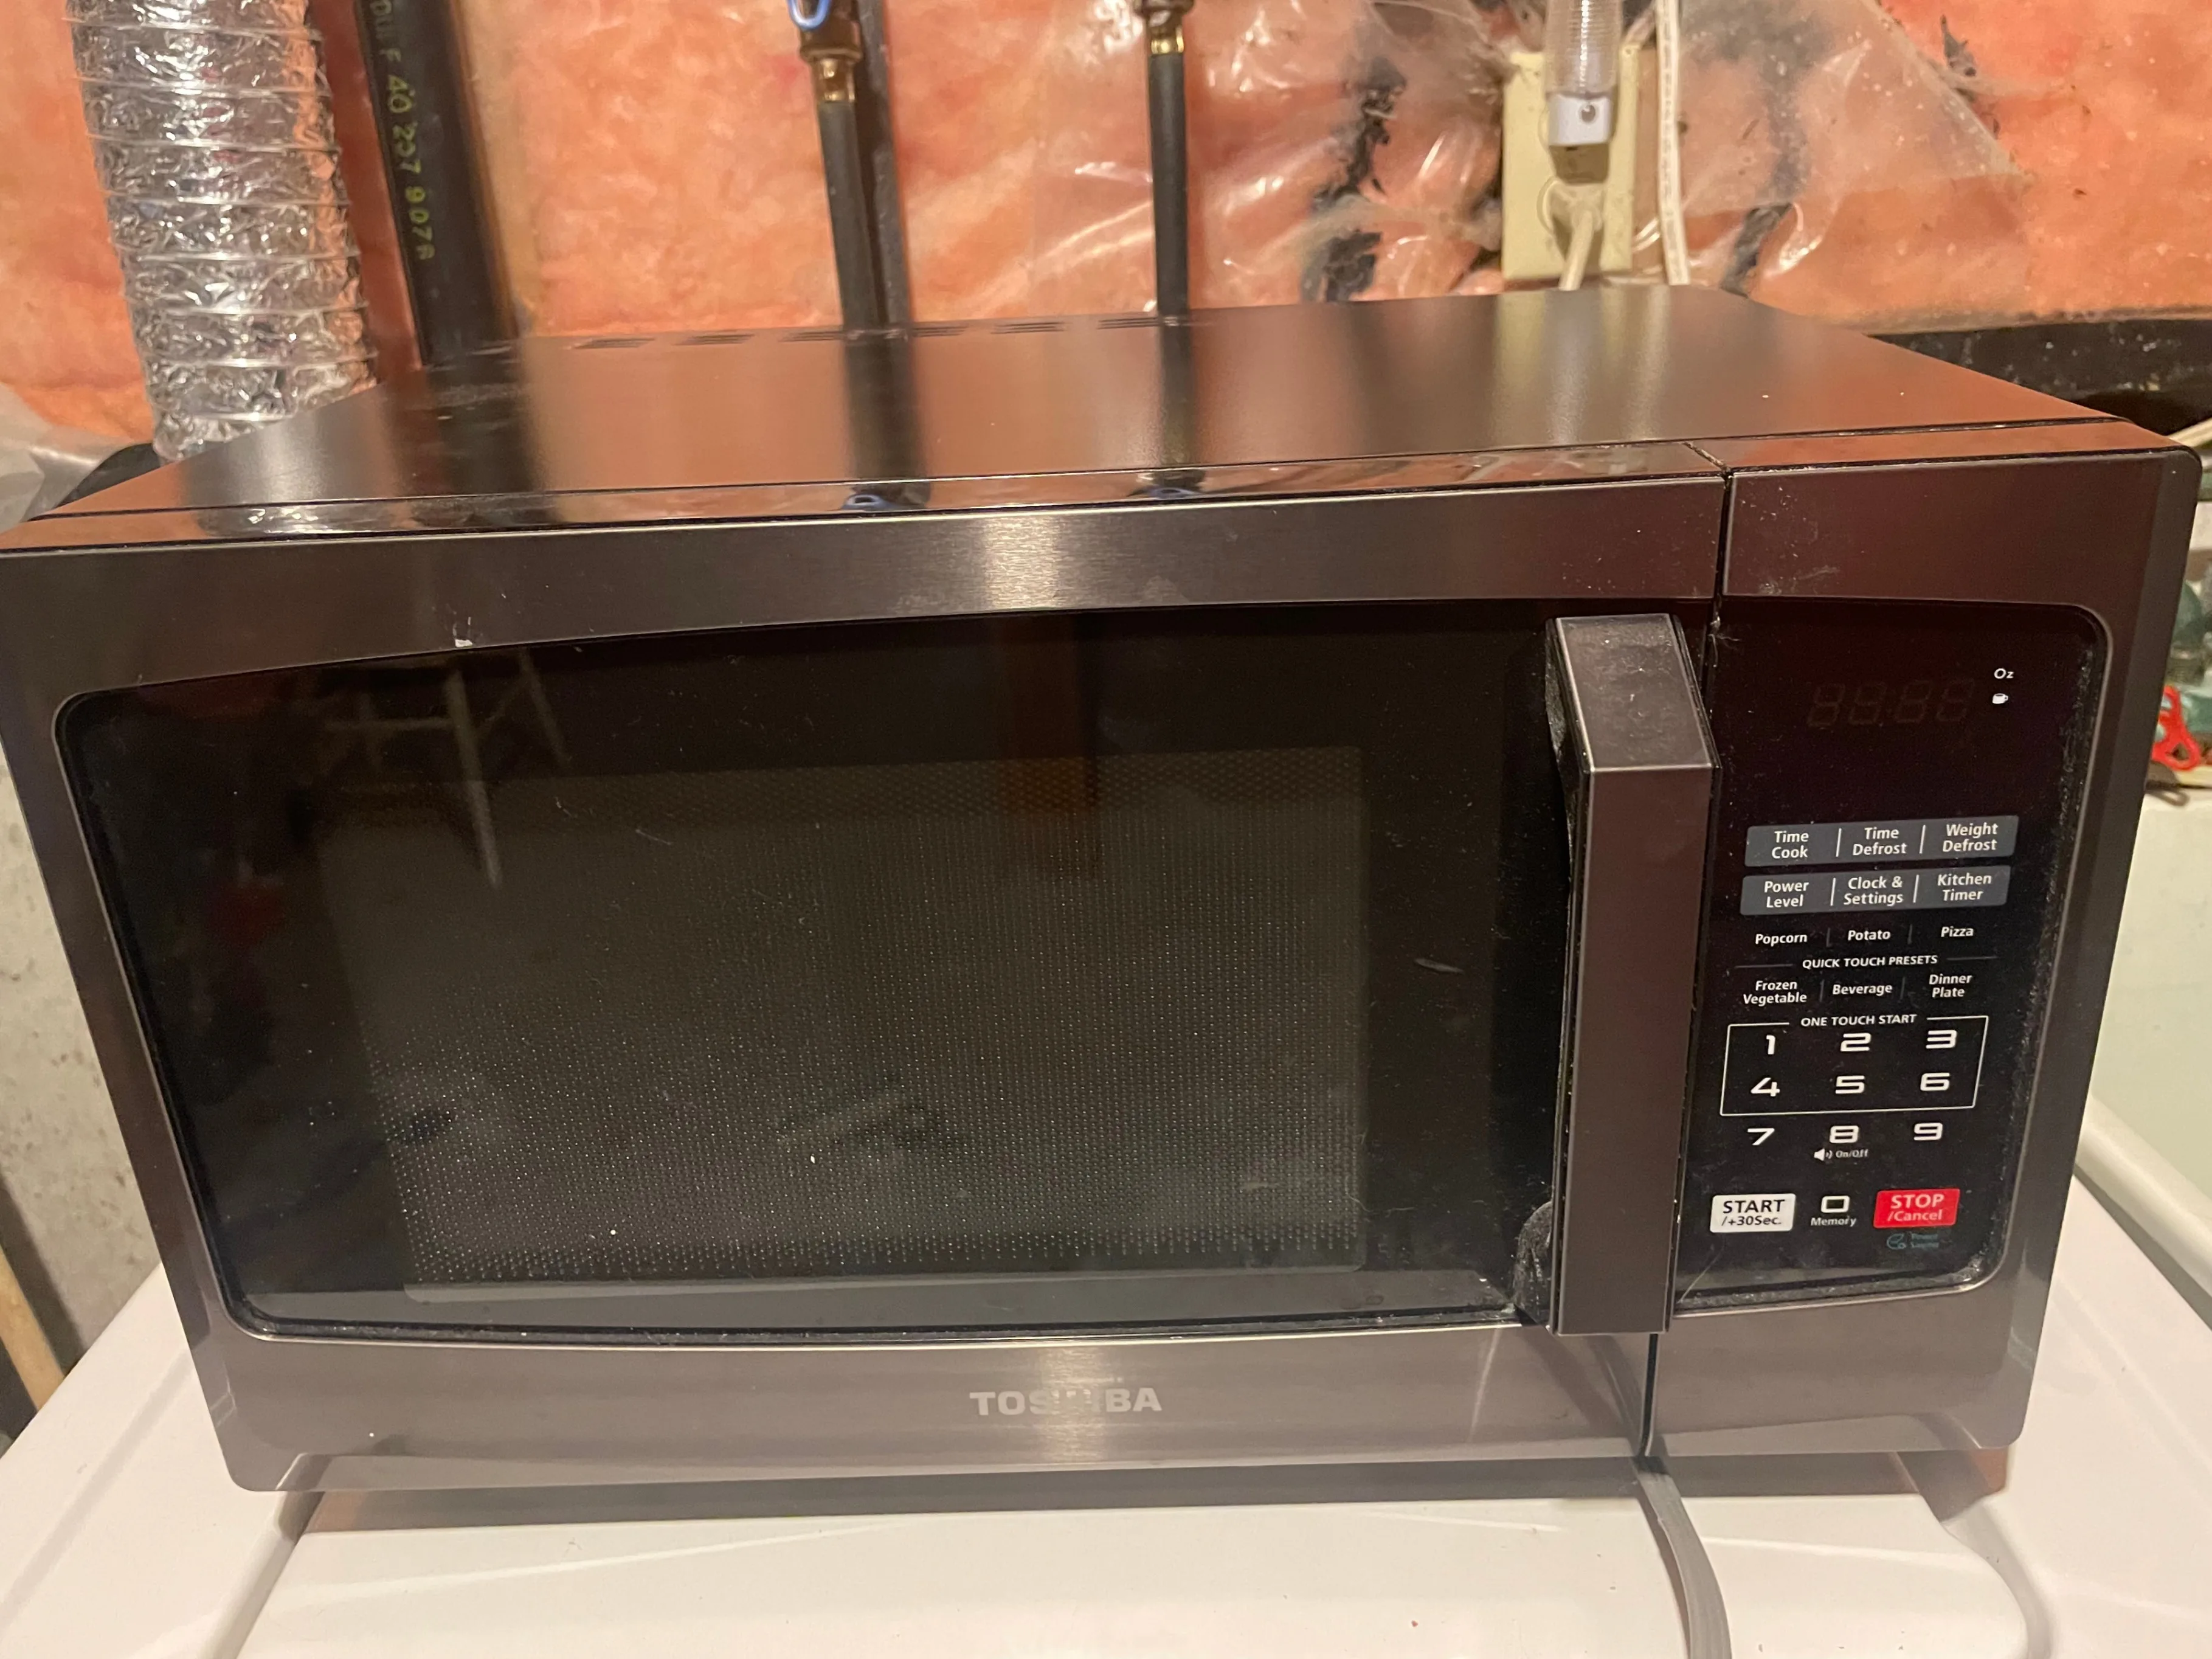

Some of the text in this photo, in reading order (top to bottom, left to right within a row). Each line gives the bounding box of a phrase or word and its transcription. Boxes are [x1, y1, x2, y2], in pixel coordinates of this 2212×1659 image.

[1994, 668, 2014, 679] Oz
[1774, 830, 1809, 843] Time
[1864, 826, 1899, 840] Time
[1946, 822, 1999, 839] Weight
[1852, 842, 1907, 856] Defrost
[1942, 836, 1997, 853] Defrost
[1771, 845, 1808, 859] Cook
[1848, 876, 1903, 890] Clock &
[1937, 872, 1992, 886] Kitchen
[1764, 881, 1809, 893] Power
[1766, 894, 1804, 908] Level
[1843, 892, 1904, 907] Settings
[1942, 888, 1983, 901] Timer
[1847, 930, 1891, 941] Potato
[1941, 926, 1974, 938] Pizza
[1755, 933, 1808, 947] Popcorn
[1802, 955, 1938, 970] QUICK TOUCH PRESETS
[1755, 980, 1798, 991] Frozen
[1929, 973, 1972, 985] Dinner
[1832, 984, 1893, 997] Beverage
[1932, 986, 1965, 998] Plate
[1743, 992, 1806, 1005] Vegetable
[1800, 1014, 1917, 1027] ONE TOUCH START
[1766, 1034, 1776, 1055] 1
[1840, 1033, 1872, 1052] 2
[1926, 1030, 1958, 1049] 3
[1751, 1077, 1780, 1097] 4
[1835, 1075, 1865, 1094] 5
[1920, 1072, 1951, 1092] 6
[1747, 1127, 1775, 1146] 7
[1829, 1125, 1859, 1143] 8
[1913, 1122, 1943, 1141] 9
[1835, 1149, 1868, 1158] On/Off
[1723, 1199, 1786, 1214] START
[1890, 1193, 1944, 1209] STOP
[1810, 1216, 1857, 1227] Memory
[1887, 1208, 1943, 1222] /Cancel
